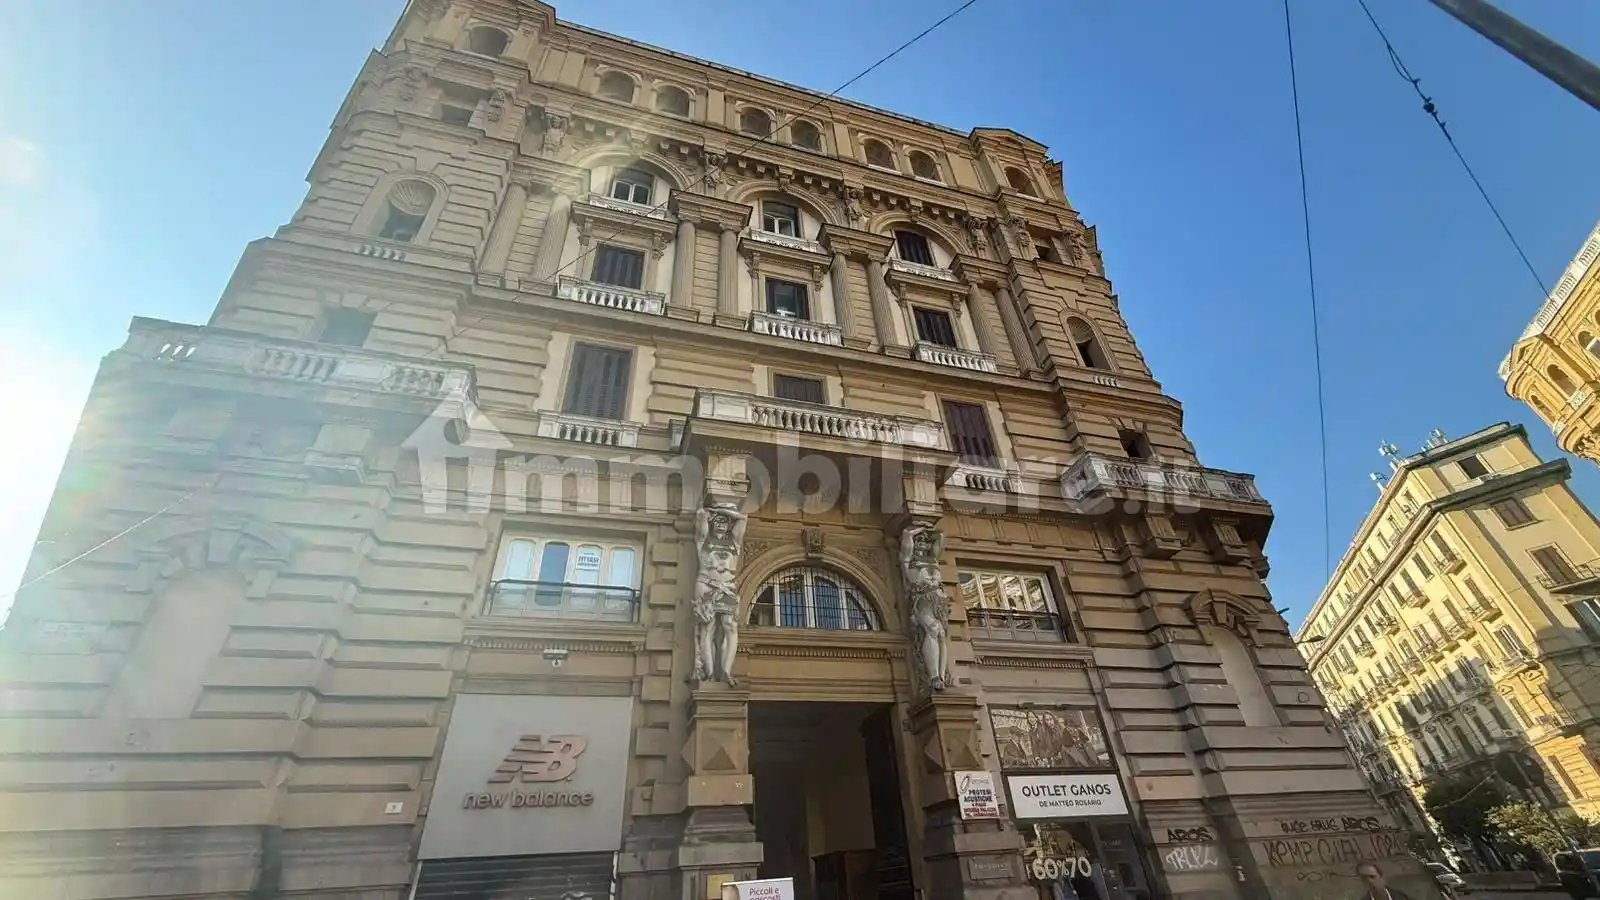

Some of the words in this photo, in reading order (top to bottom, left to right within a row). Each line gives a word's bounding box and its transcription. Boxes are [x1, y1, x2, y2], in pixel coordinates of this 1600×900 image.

[1022, 784, 1067, 798] OUTLET
[463, 790, 508, 811] new
[511, 786, 595, 809] balance
[1039, 800, 1048, 808] DE
[1050, 799, 1074, 808] MATTEO
[1075, 799, 1102, 807] ROSARIO
[749, 886, 773, 896] Piccoli
